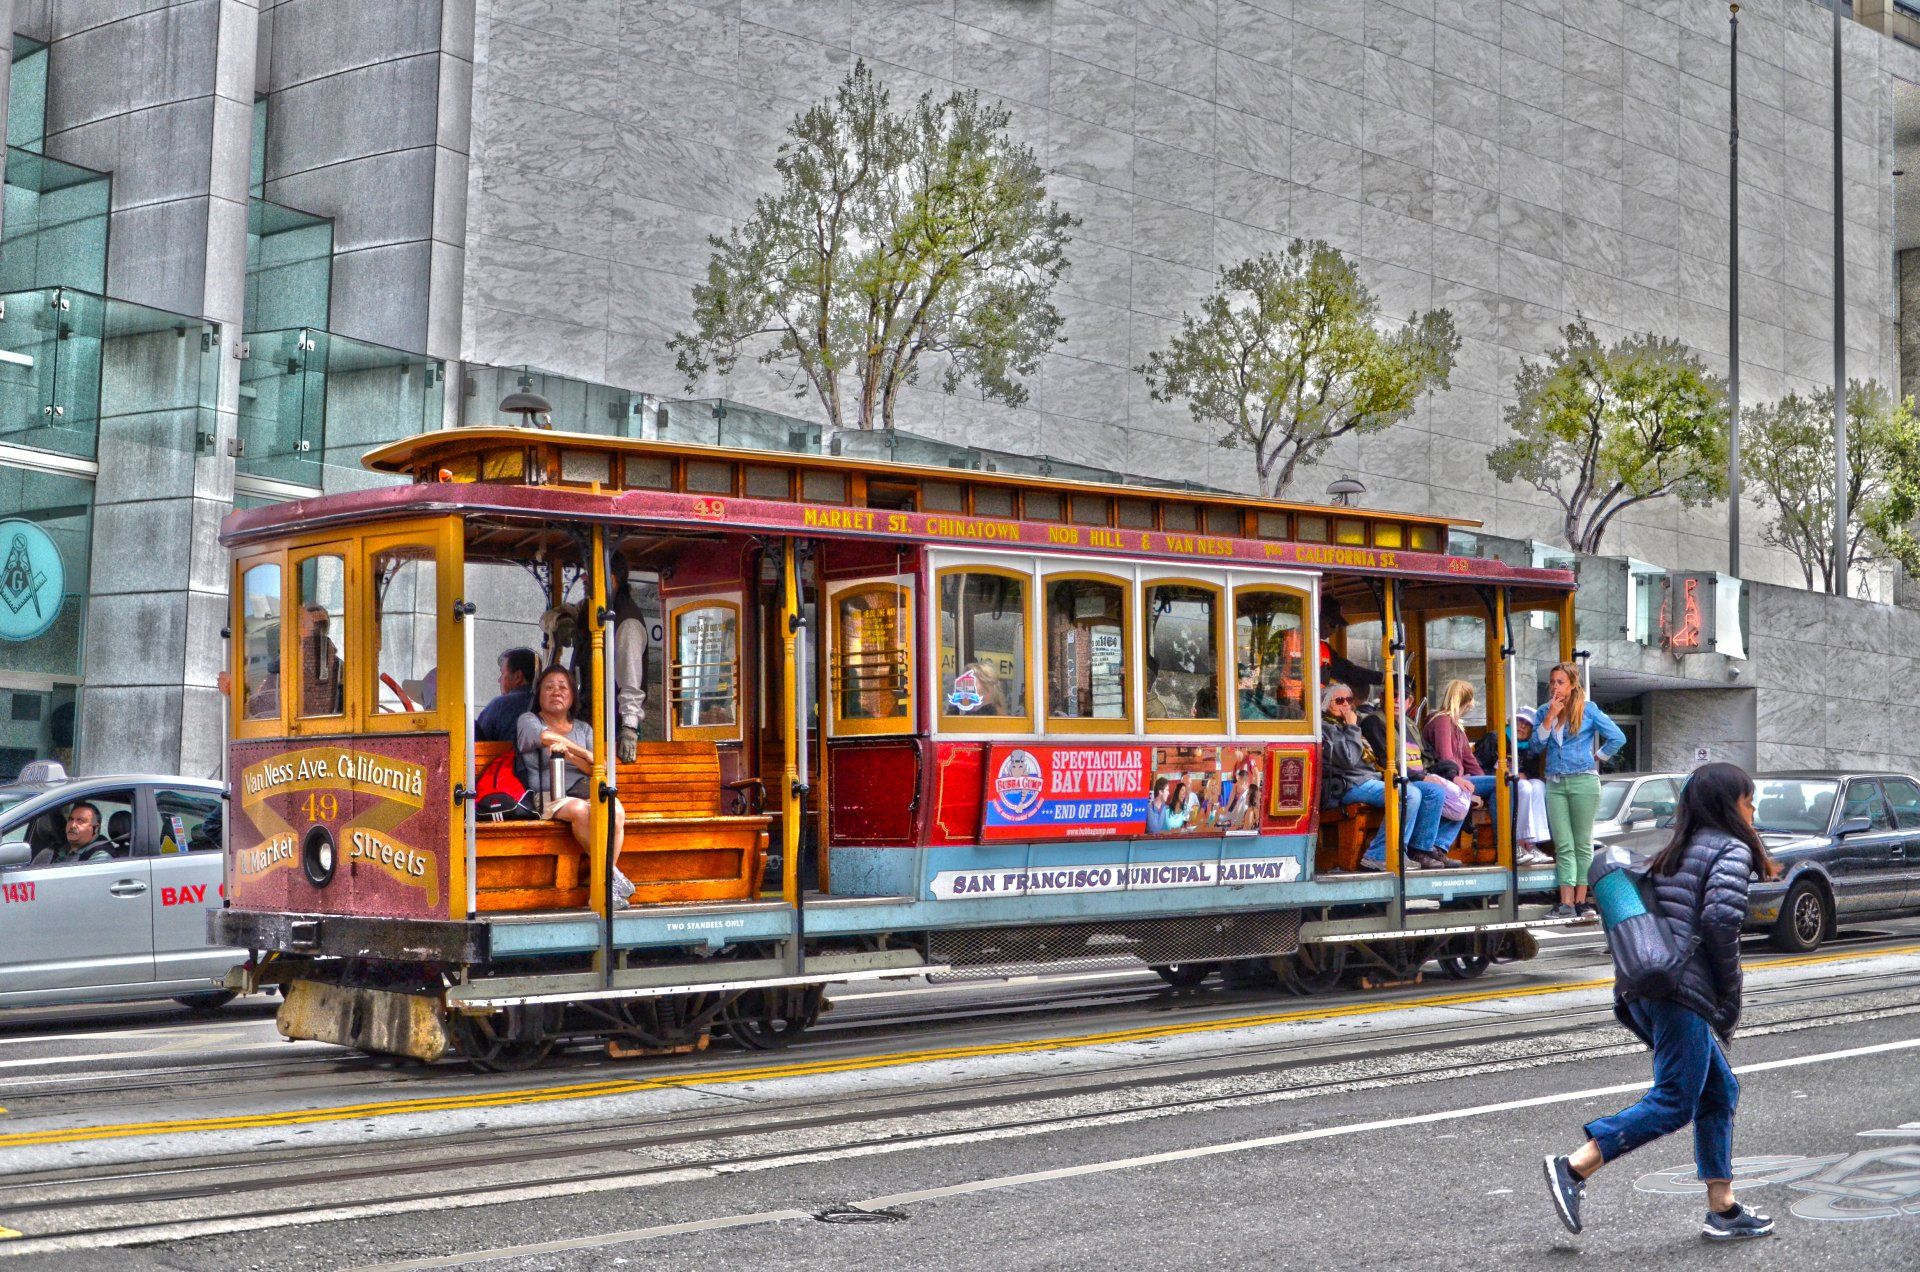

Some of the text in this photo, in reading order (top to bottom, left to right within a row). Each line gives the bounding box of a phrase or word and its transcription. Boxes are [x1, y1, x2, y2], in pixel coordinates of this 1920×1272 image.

[693, 500, 725, 518] 49
[804, 507, 874, 531] MARKET
[926, 518, 1020, 541] CHINATOWN
[1050, 527, 1079, 545] NOB
[1090, 530, 1124, 548] HILL
[1166, 536, 1193, 554] VAN
[1198, 539, 1233, 556] NESS
[1296, 546, 1376, 567] CALIFORNIA
[1447, 559, 1469, 572] 49
[1052, 750, 1143, 770] SPECTACULAR
[244, 772, 265, 795] Van
[264, 763, 294, 788] Ness
[337, 754, 422, 797] California
[1051, 769, 1143, 793] BAY VIEWS!
[301, 793, 339, 822] 49
[1054, 804, 1073, 819] END
[1078, 804, 1092, 819] OF
[1093, 803, 1118, 818] PIER
[1120, 803, 1133, 818] 39
[251, 836, 293, 873] Market
[351, 831, 426, 877] Streets
[953, 862, 1284, 894] SAN FRANCISCO MUNICIPAL RAILWAY
[1, 881, 36, 903] 1437
[161, 883, 208, 906] BAY
[667, 919, 745, 931] TWO STANDEES ONLY
